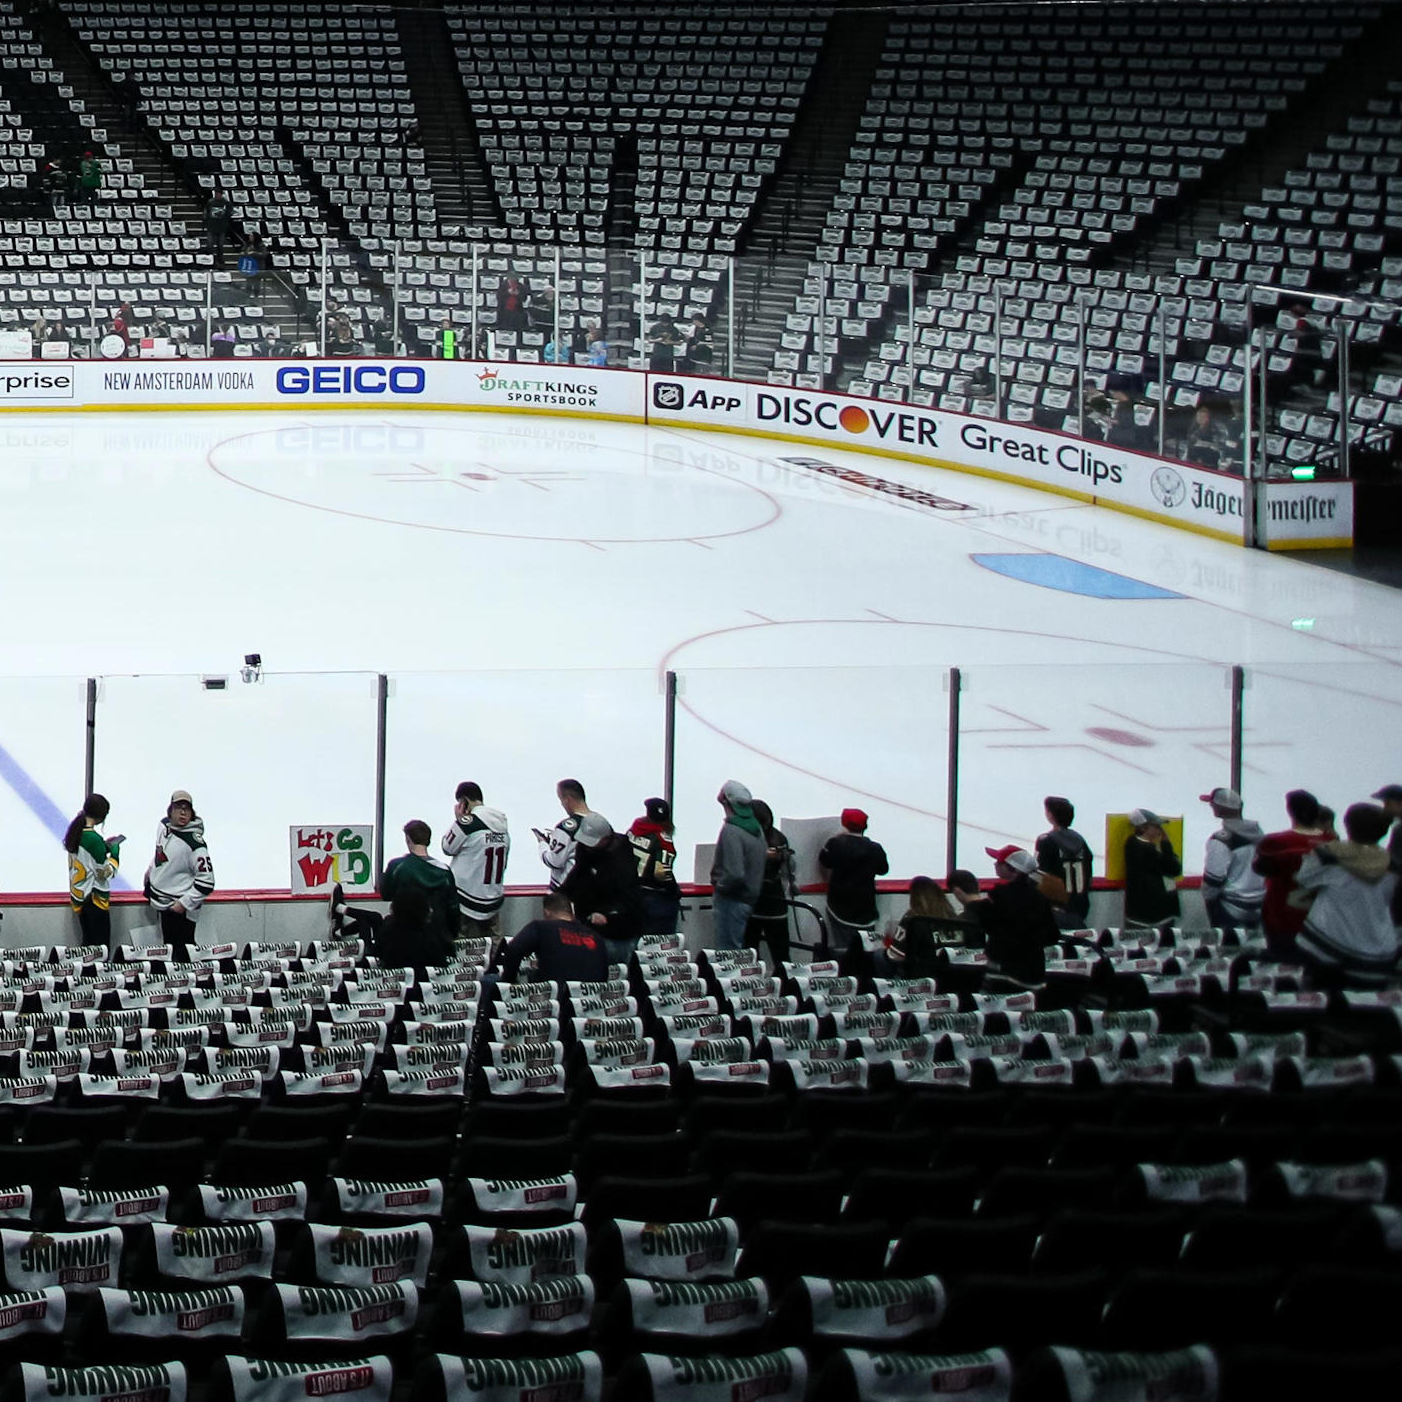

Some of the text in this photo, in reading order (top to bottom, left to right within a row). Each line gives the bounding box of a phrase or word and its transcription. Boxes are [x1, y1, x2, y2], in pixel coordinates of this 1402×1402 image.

[104, 372, 254, 390] NEW AMSTERDAM VODKA
[276, 366, 425, 394] GEICO
[479, 375, 598, 396] DRAFTKINGS
[507, 393, 597, 407] SPORTSBOOK
[757, 393, 940, 447] DISCOVER
[960, 424, 1124, 486] Great Clips
[197, 857, 213, 872] 25
[484, 847, 504, 884] 11
[1063, 862, 1083, 893] 11
[310, 1375, 345, 1395] ABOUT
